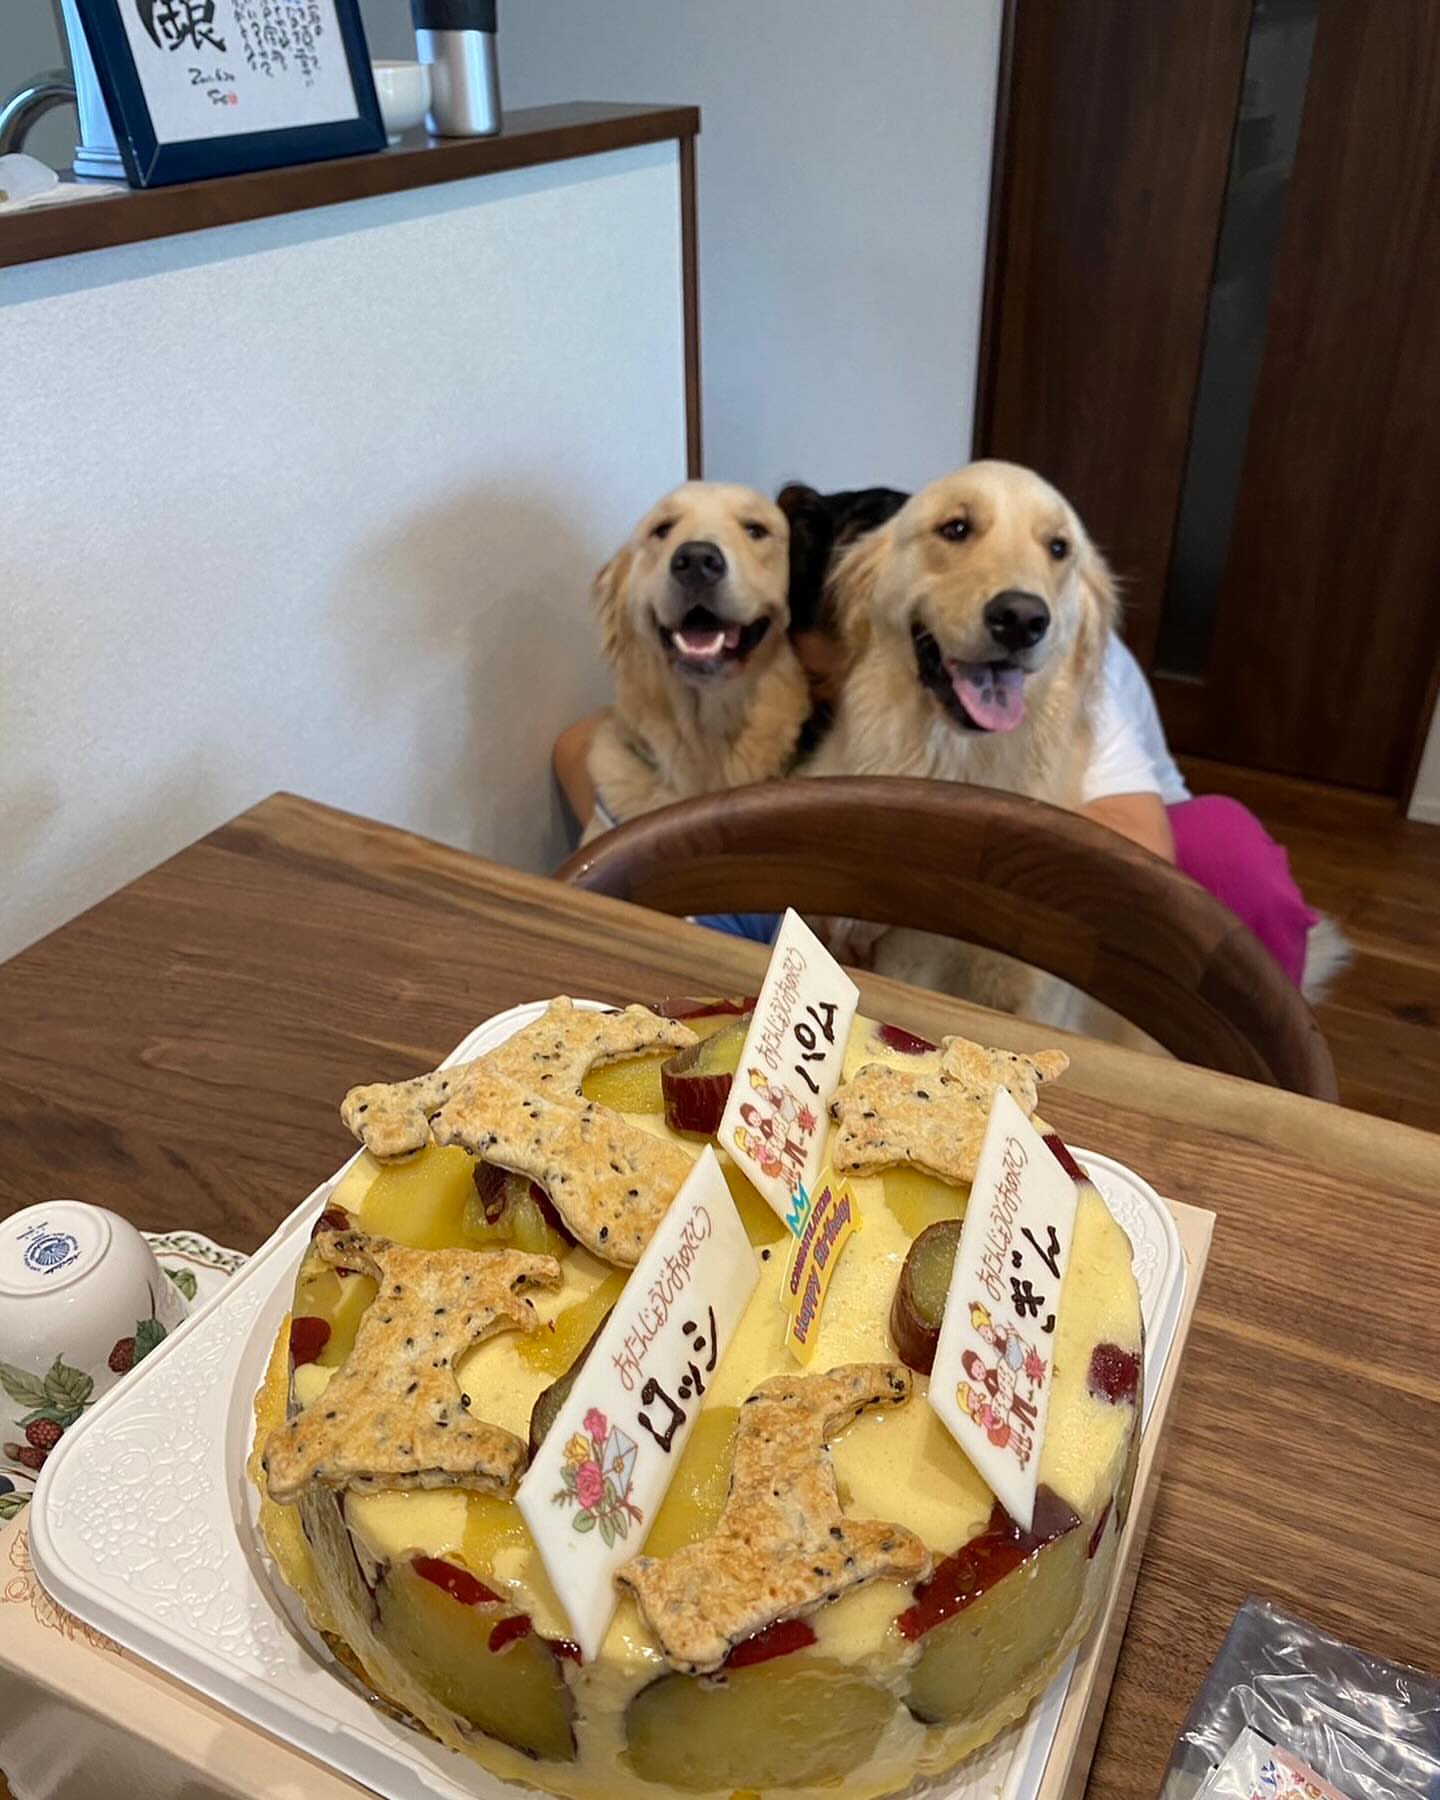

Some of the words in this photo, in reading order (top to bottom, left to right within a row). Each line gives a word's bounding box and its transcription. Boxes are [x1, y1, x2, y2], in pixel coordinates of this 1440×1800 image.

[795, 1001, 839, 1095] パム
[793, 1264, 821, 1344] Happy
[813, 1192, 851, 1270] Birthday
[1010, 1225, 1061, 1334] ぎん
[638, 1305, 718, 1453] ロッシ
